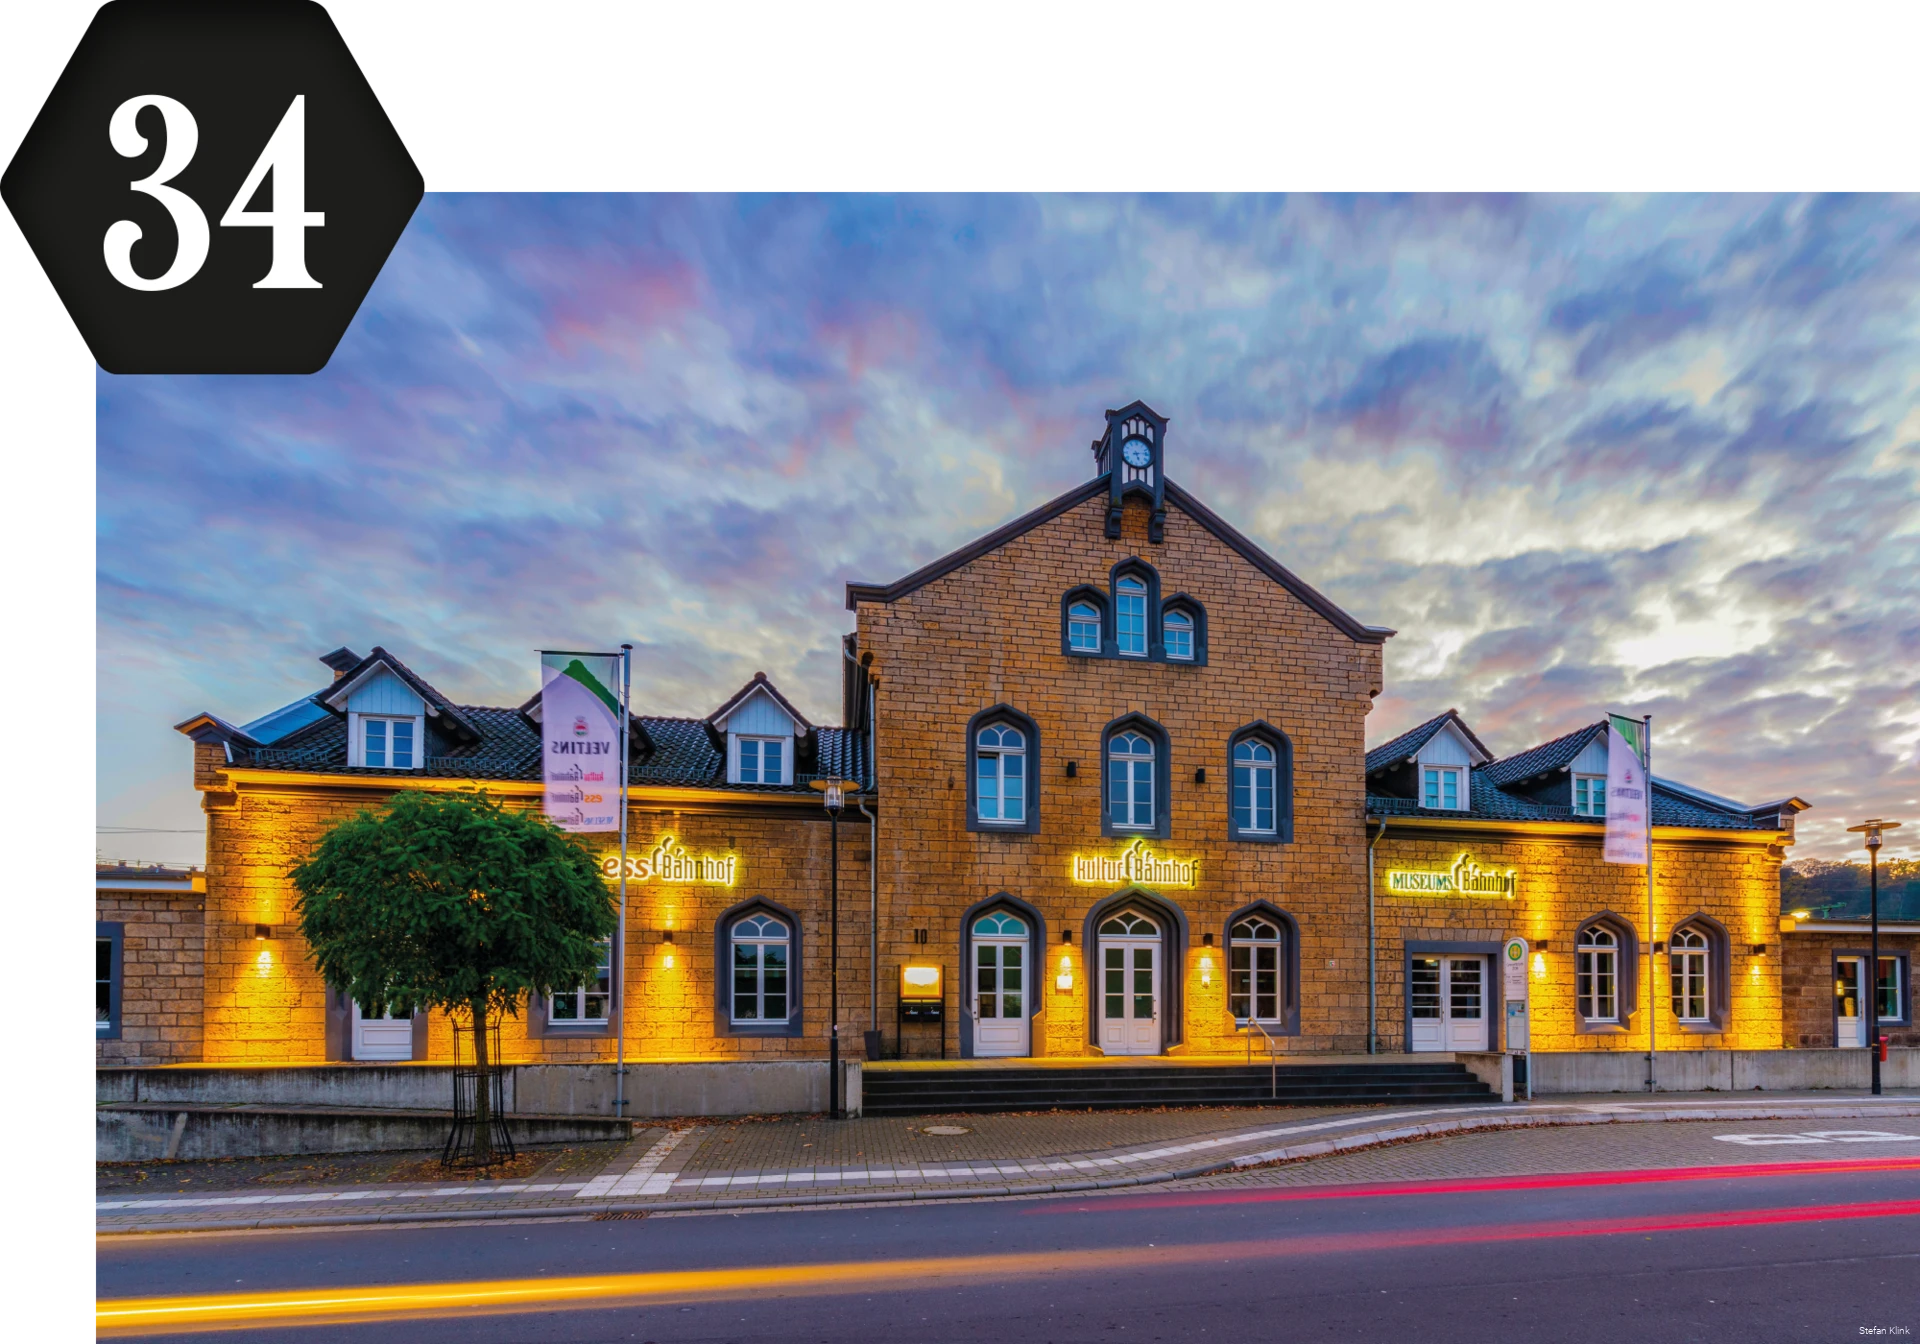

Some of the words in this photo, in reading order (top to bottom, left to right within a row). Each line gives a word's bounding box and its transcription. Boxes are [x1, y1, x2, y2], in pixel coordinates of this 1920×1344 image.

[602, 857, 649, 878] ess
[662, 853, 734, 885] Bahnhof
[1076, 856, 1123, 880] kultur
[1134, 857, 1198, 886] Bahnhof
[1392, 873, 1453, 891] MUSEUMS
[914, 928, 927, 944] 10
